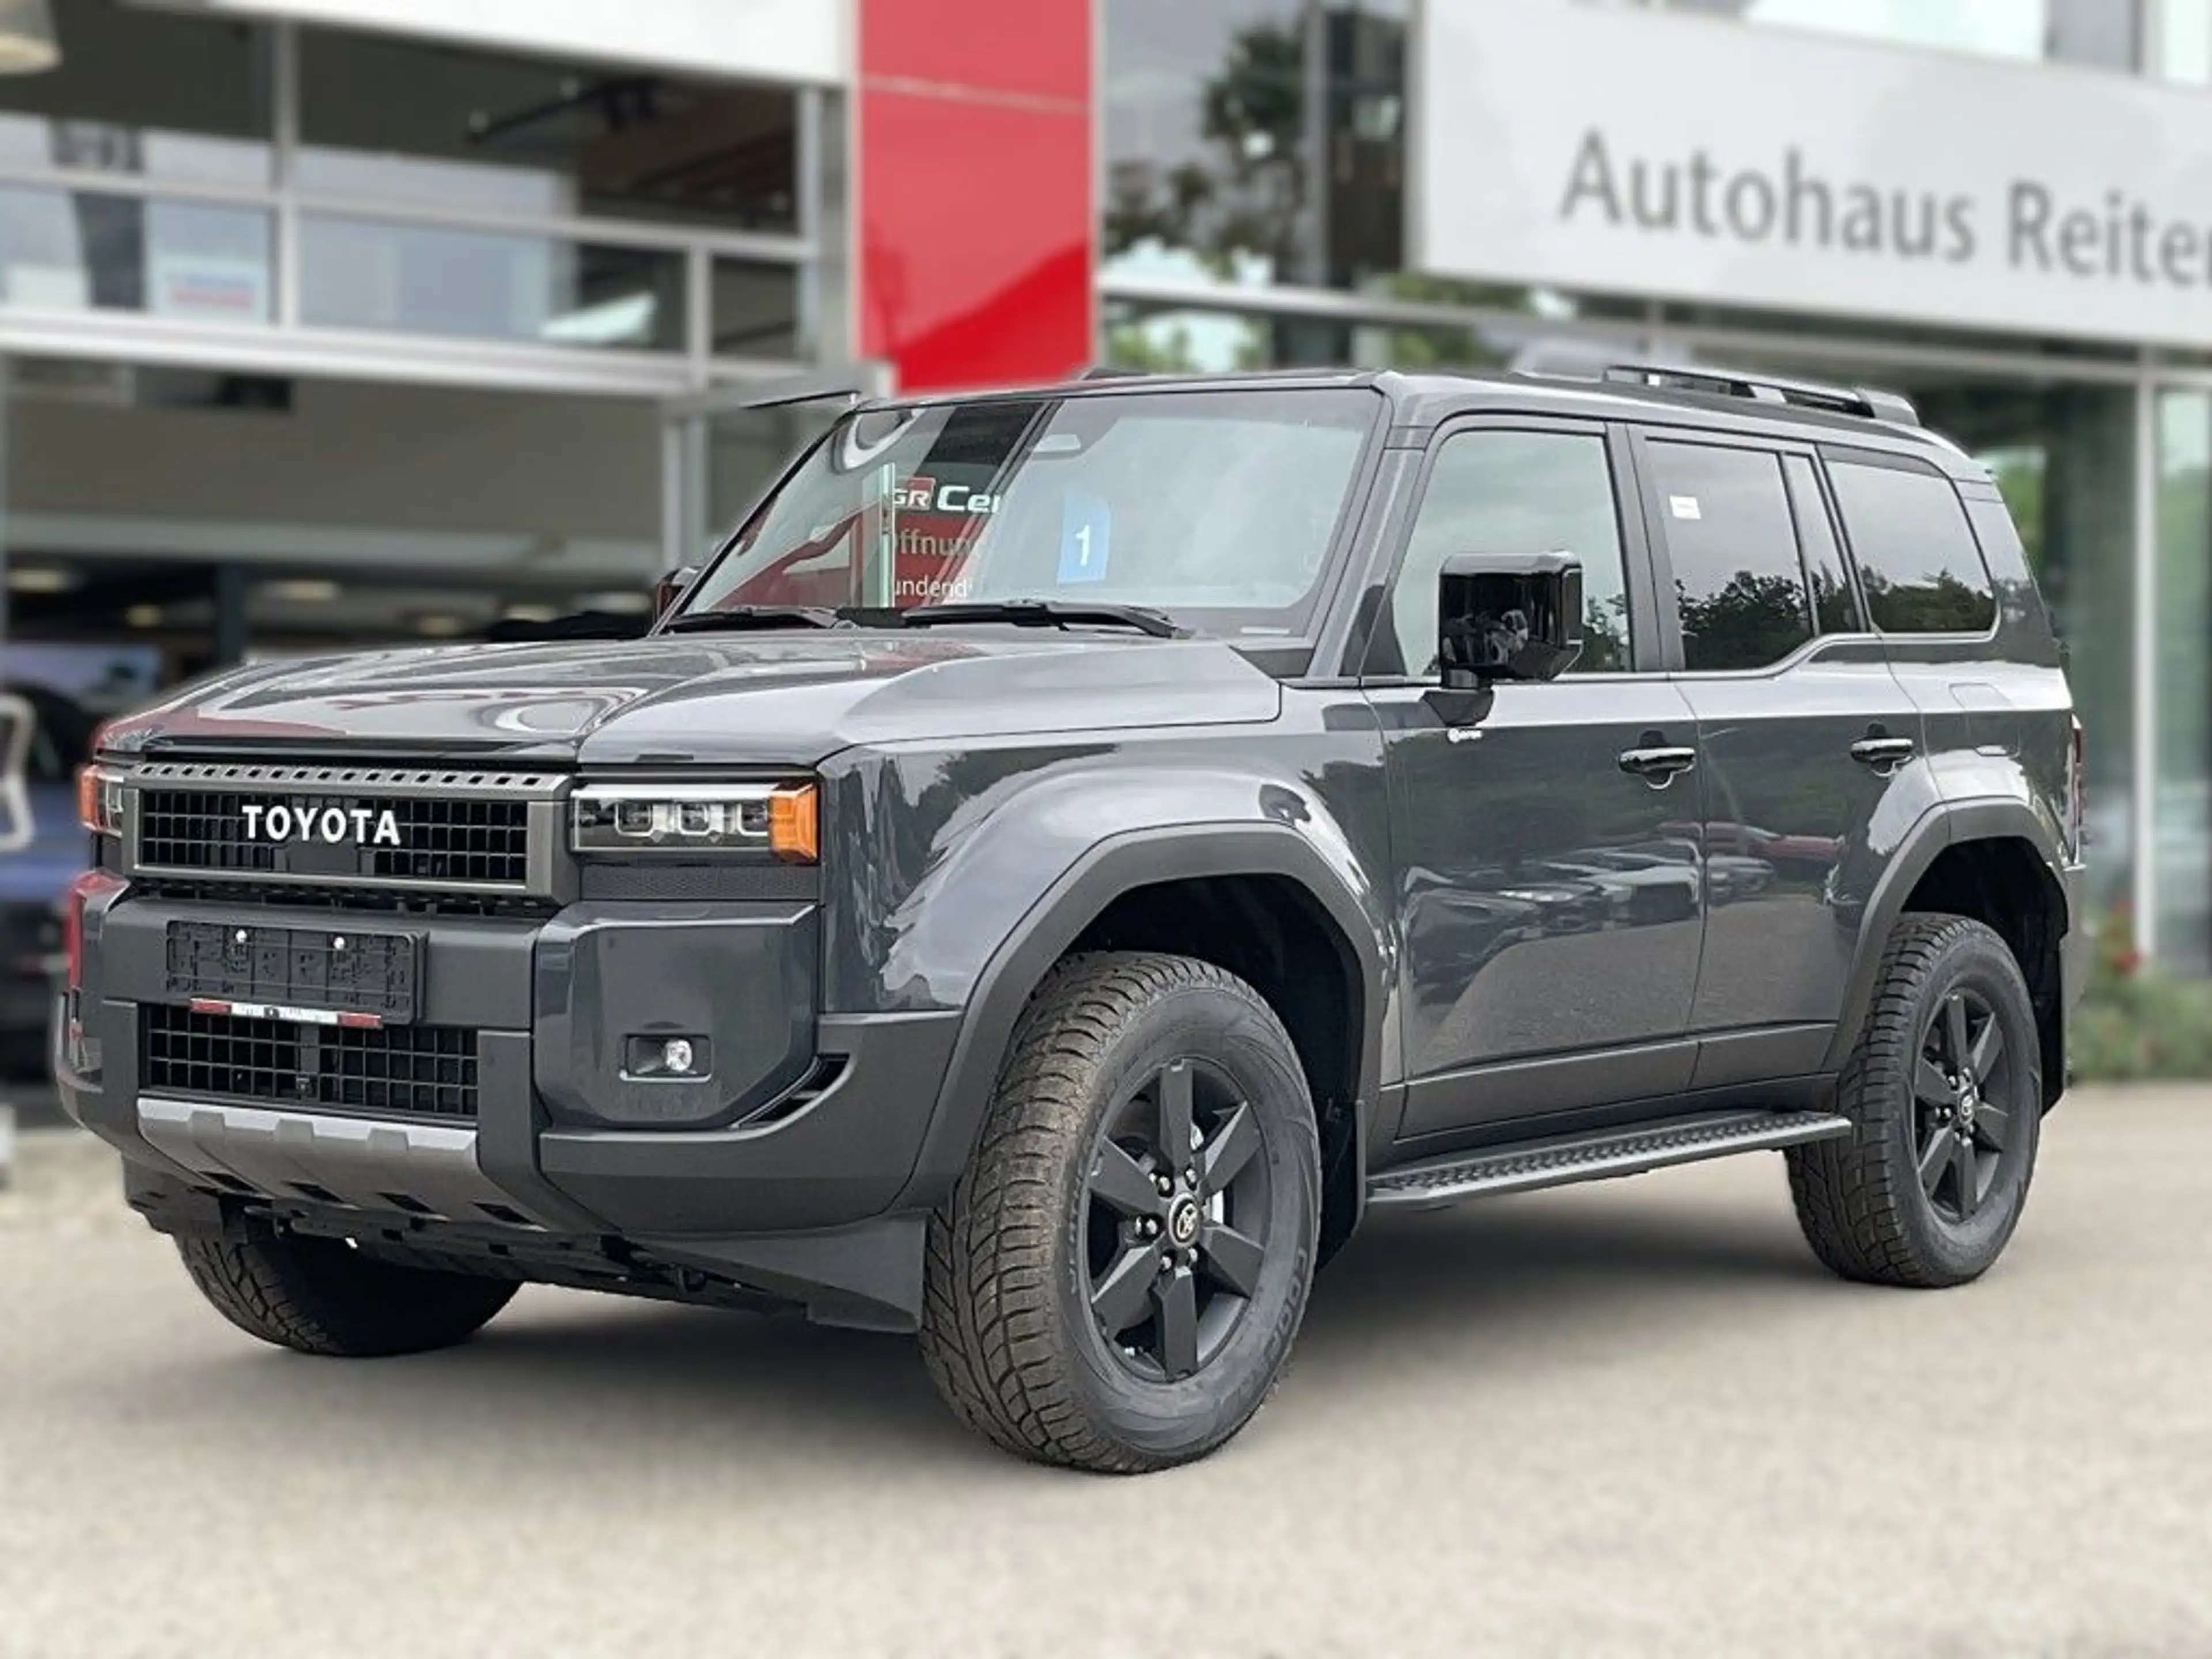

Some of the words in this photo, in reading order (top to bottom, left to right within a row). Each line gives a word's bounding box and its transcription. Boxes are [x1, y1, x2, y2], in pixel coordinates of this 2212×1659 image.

[1558, 128, 1976, 264] Autohaus
[2007, 180, 2212, 291] Reite
[1074, 524, 1090, 567] 1
[241, 805, 401, 846] TOYOTA
